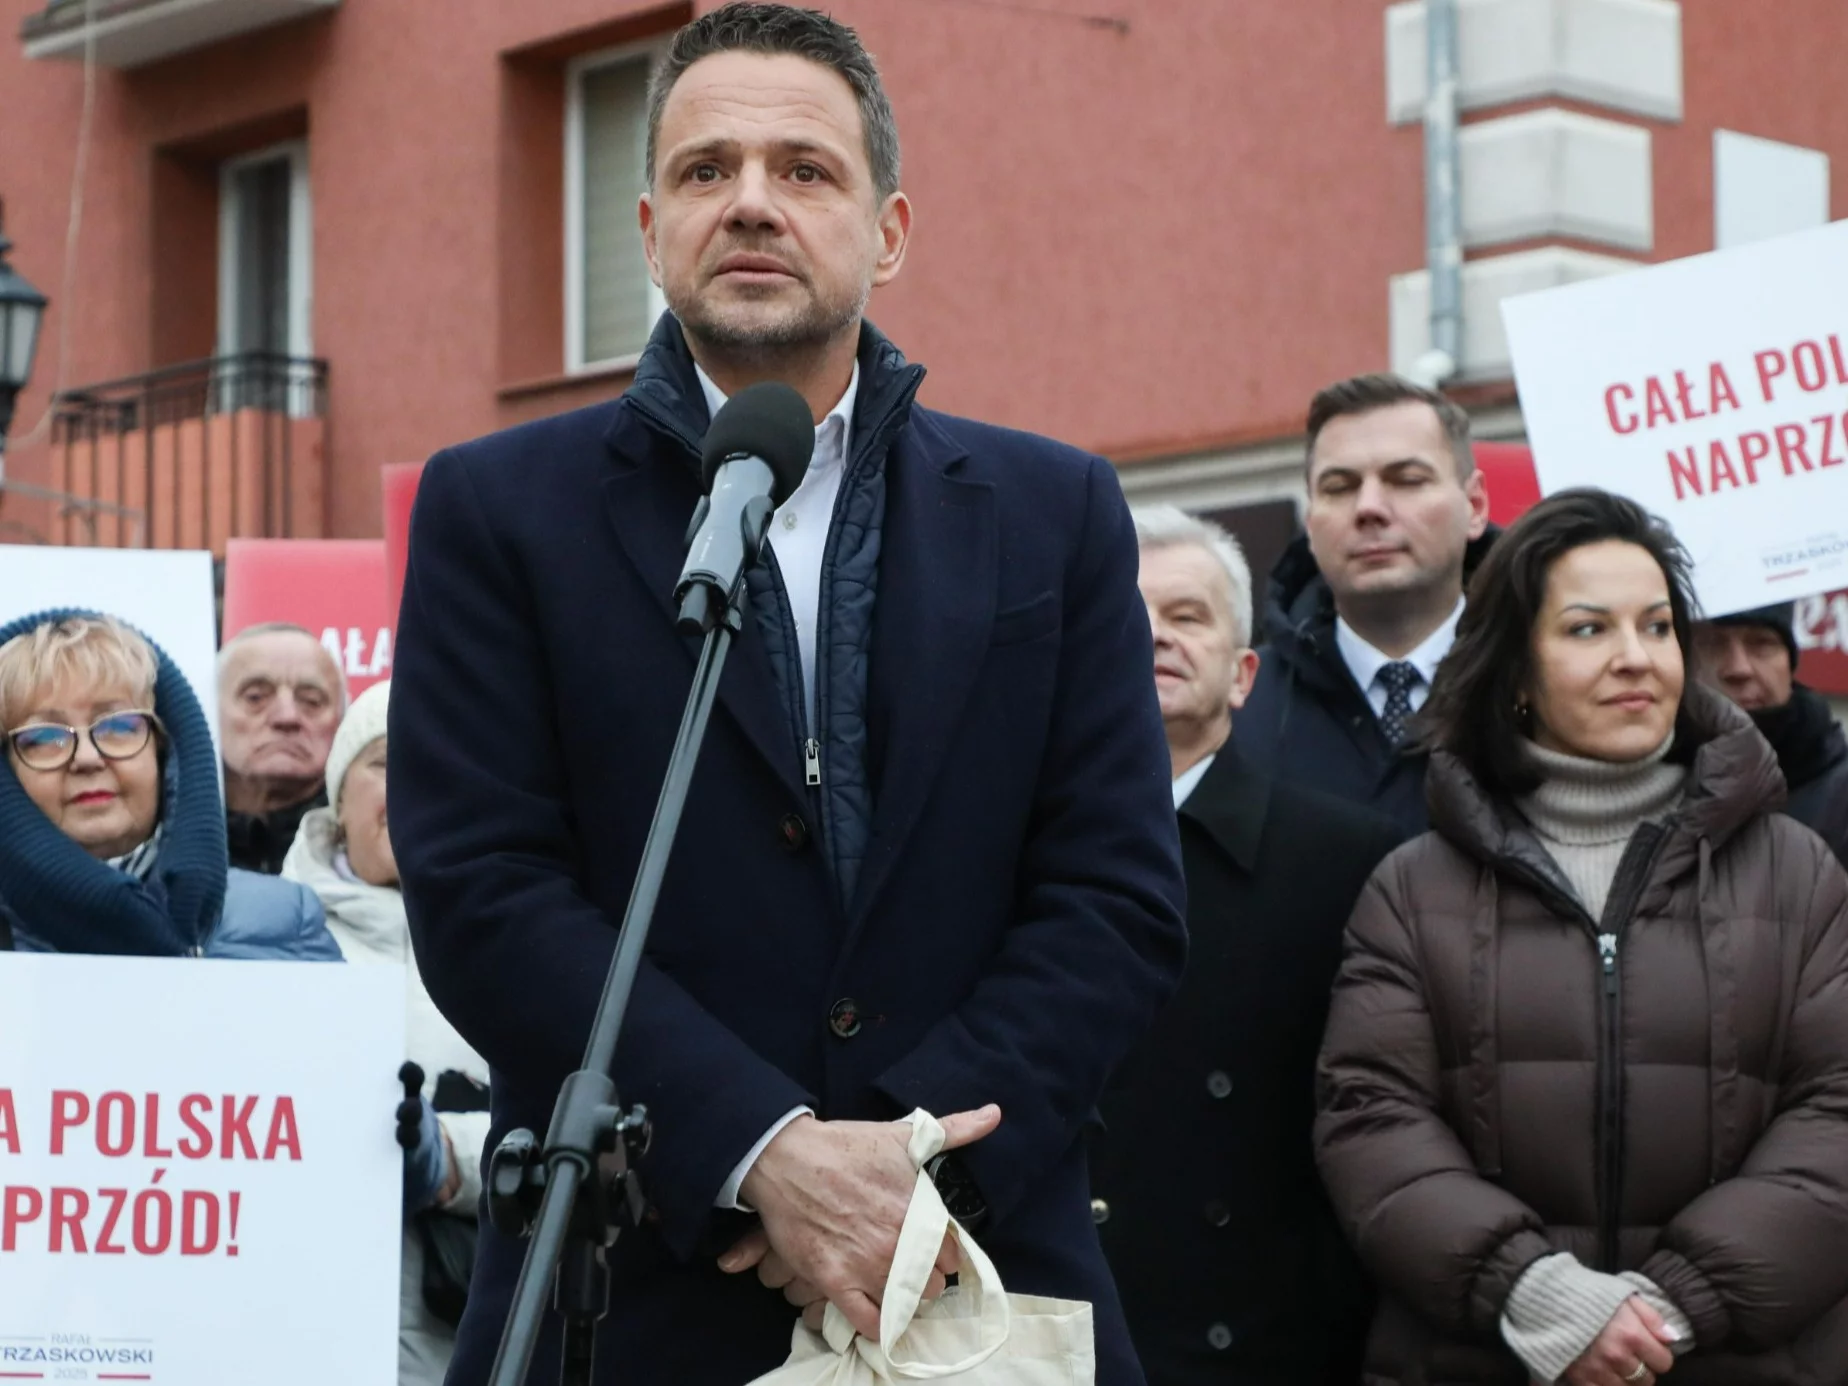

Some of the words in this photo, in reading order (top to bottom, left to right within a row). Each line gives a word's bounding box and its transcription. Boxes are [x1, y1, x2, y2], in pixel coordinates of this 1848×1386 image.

[1604, 361, 1741, 436] CAŁA
[1754, 334, 1848, 402] POL
[1666, 410, 1848, 501] NAPRZ
[50, 1090, 302, 1161] POLSKA
[2, 1168, 241, 1256] PRZÓD!
[54, 1367, 88, 1380] 2025
